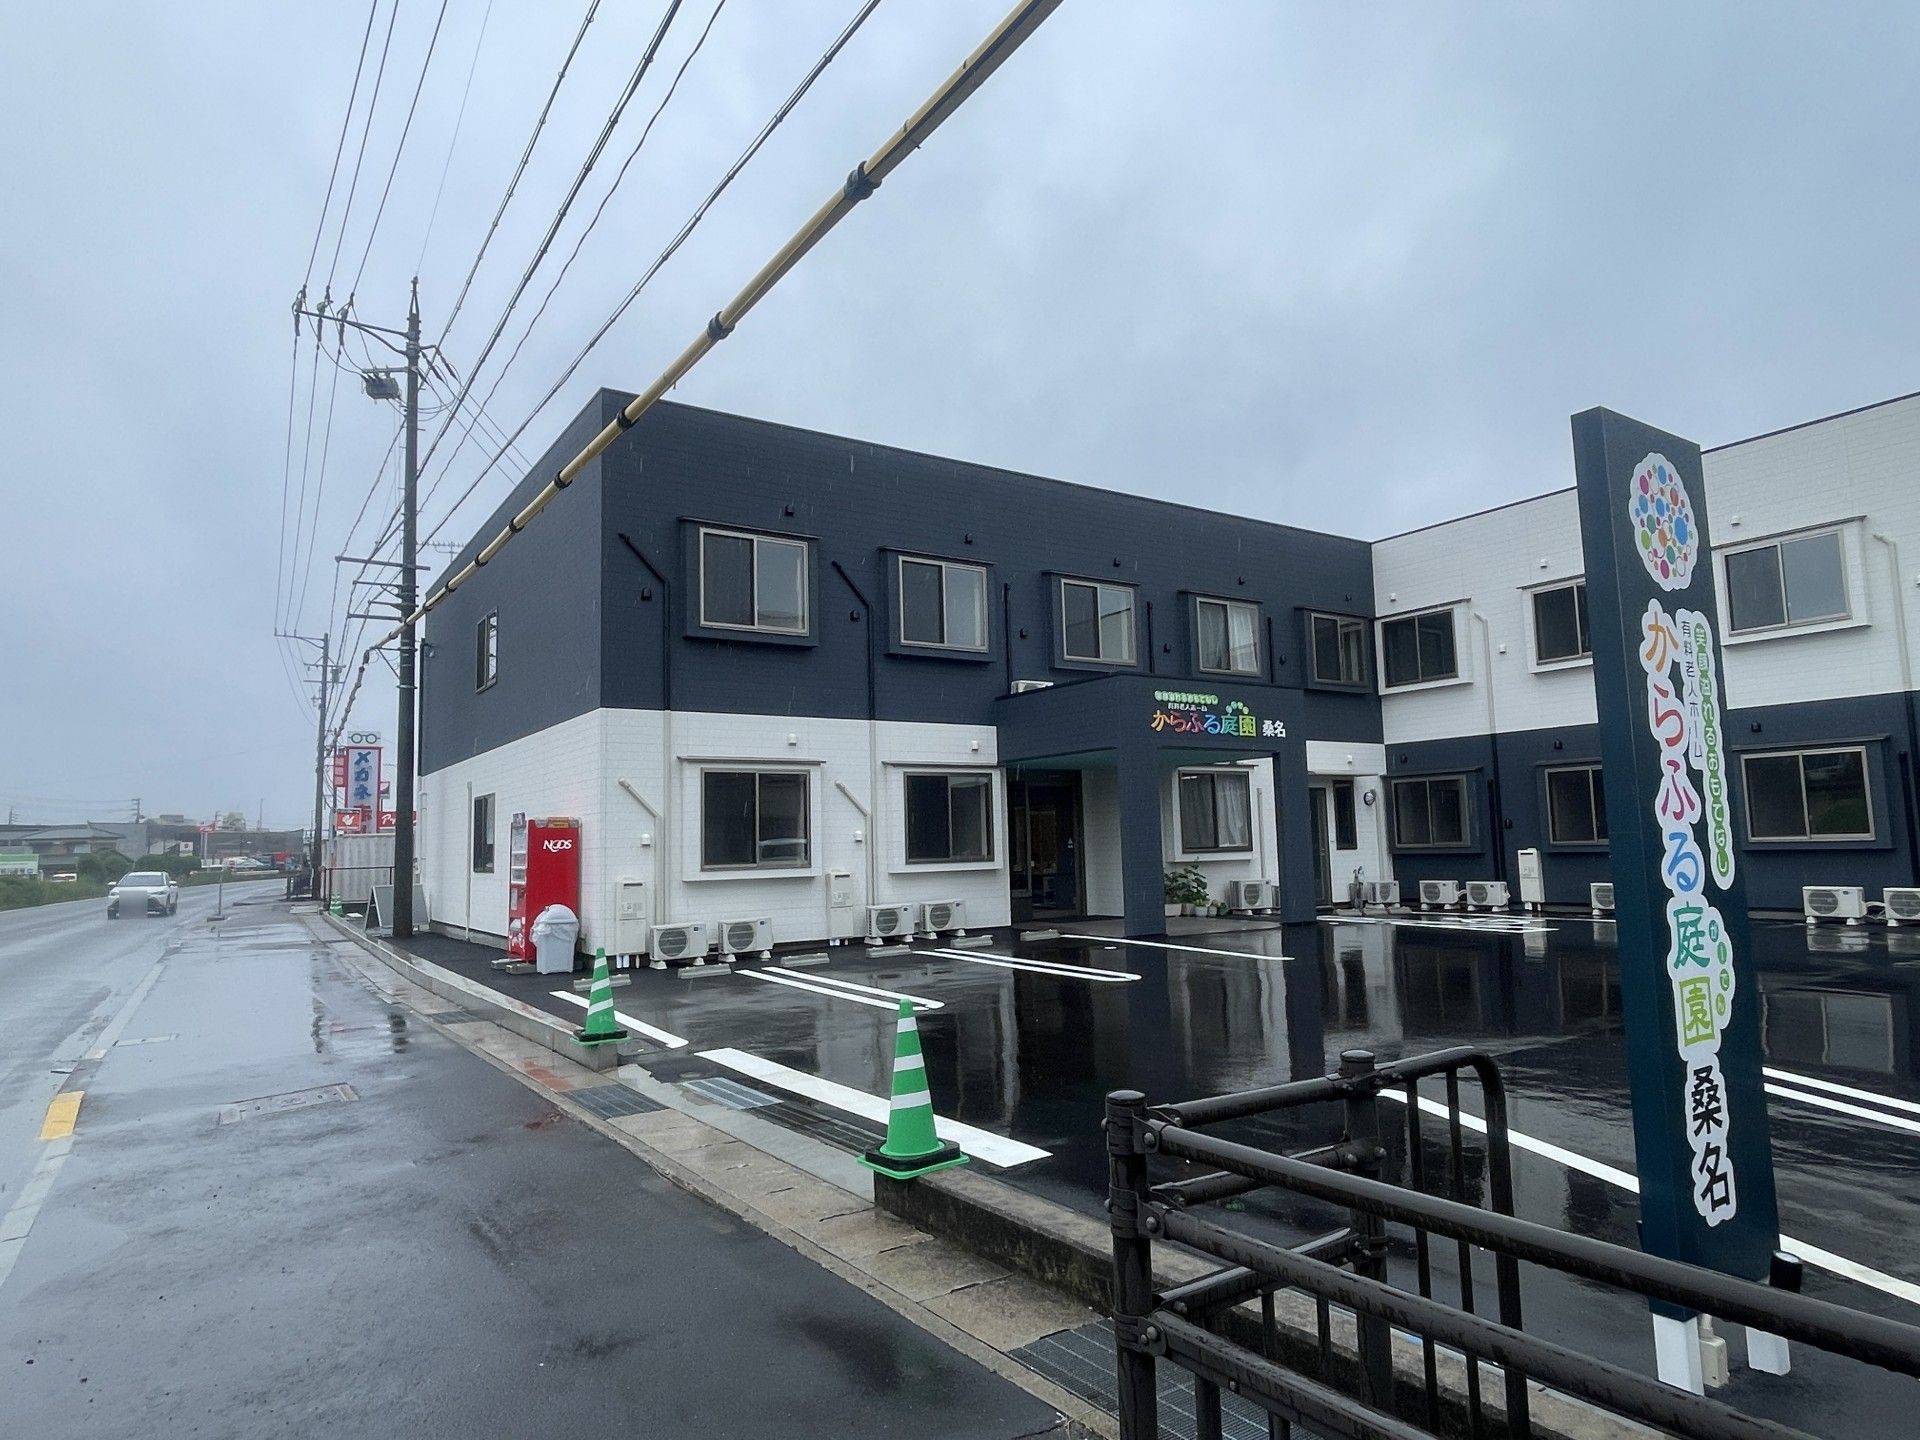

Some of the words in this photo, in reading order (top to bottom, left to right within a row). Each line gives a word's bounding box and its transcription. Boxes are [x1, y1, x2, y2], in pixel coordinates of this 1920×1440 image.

[1150, 710, 1257, 737] からふる庭園
[1262, 719, 1287, 738] 桑名
[1645, 611, 1715, 1047] からふる庭園
[1691, 1065, 1731, 1212] 桑名
